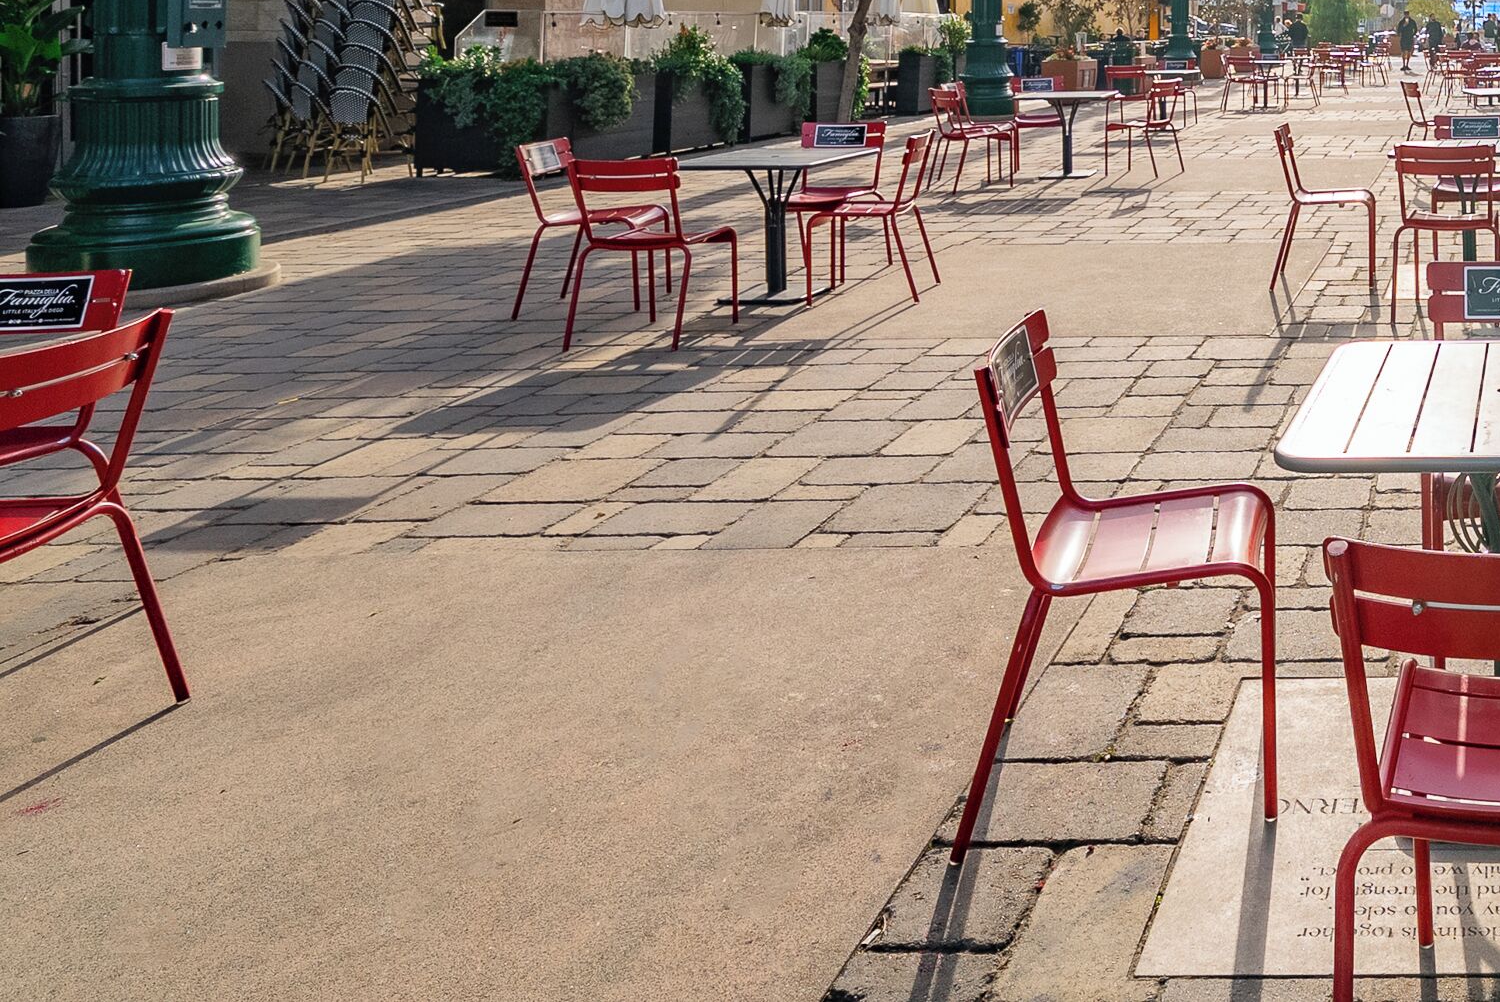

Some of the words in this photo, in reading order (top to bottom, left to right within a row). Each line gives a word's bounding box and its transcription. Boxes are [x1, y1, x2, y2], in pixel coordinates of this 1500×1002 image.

[0, 284, 76, 318] Famiglia
[1434, 865, 1464, 875] we
[1300, 886, 1331, 901] for
[1435, 885, 1469, 899] the
[1328, 905, 1397, 920] sele.
[1436, 902, 1474, 915] you
[1297, 923, 1393, 942] togher
[1402, 926, 1417, 940] is
